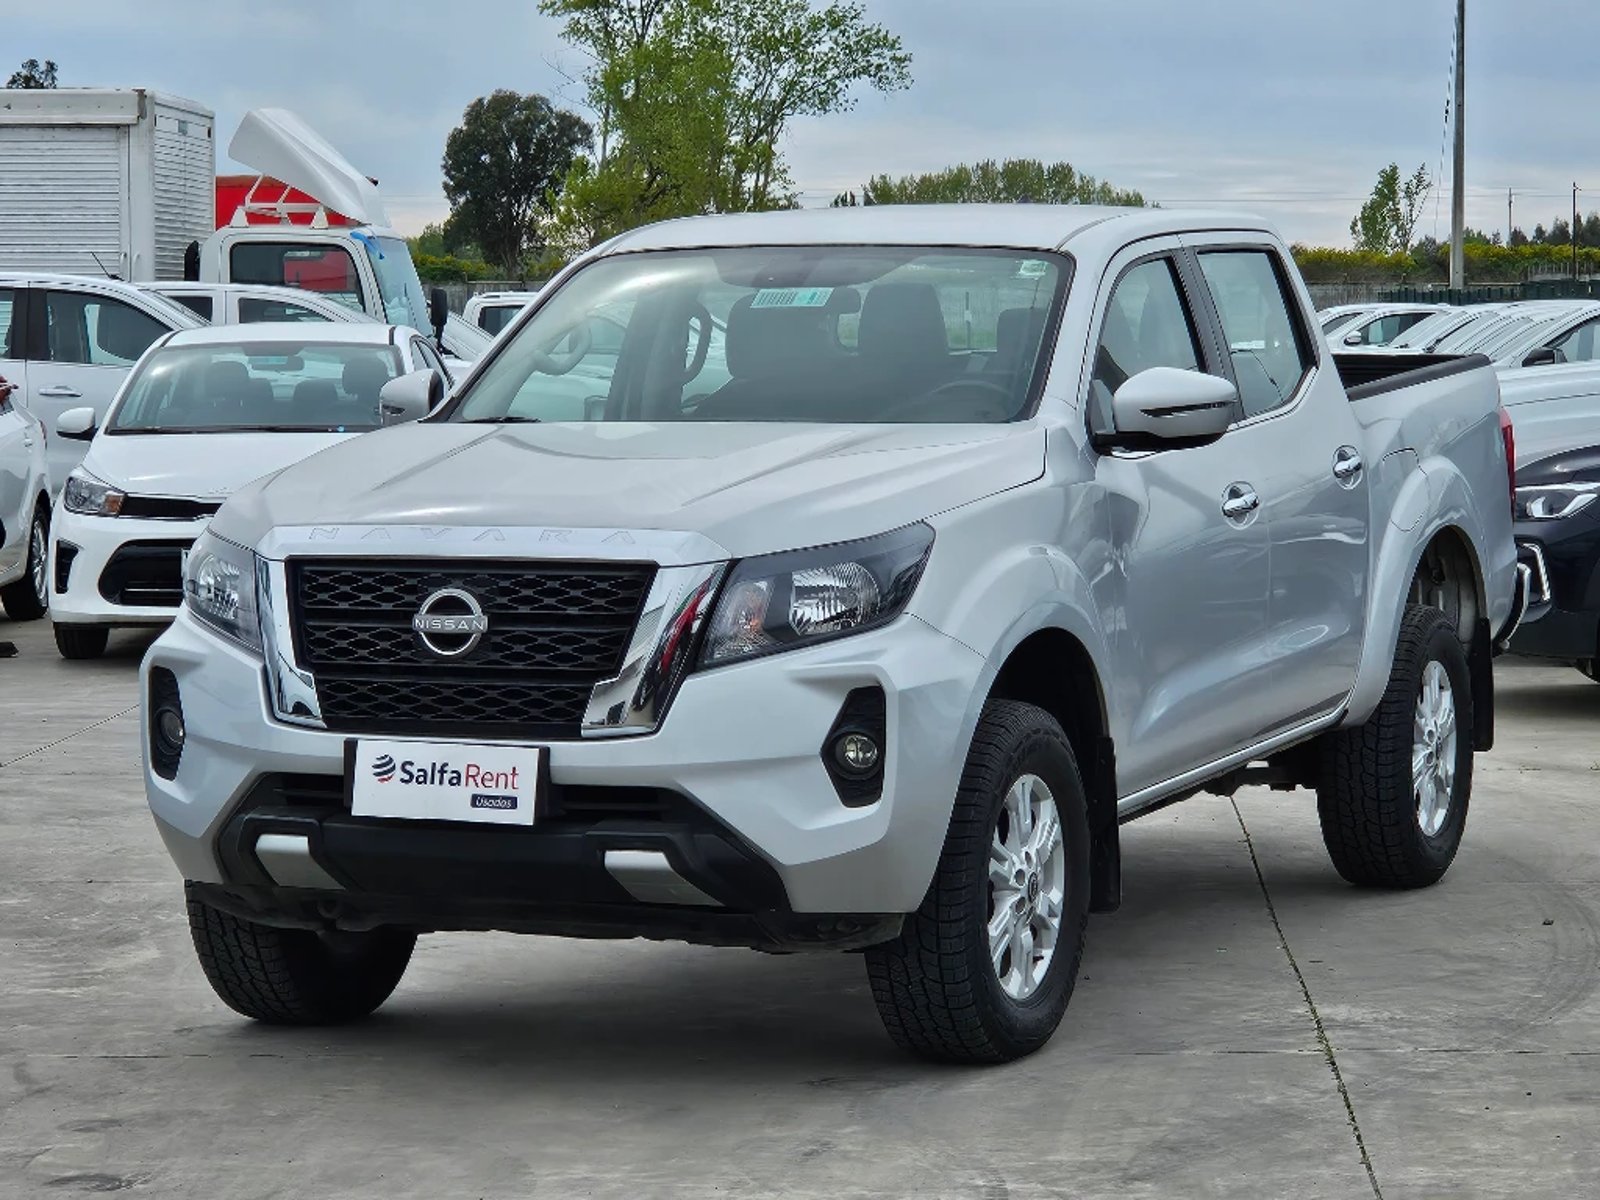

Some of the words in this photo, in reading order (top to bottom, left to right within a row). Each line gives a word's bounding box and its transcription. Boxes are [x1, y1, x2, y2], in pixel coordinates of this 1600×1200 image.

[308, 527, 636, 544] NAVARA
[415, 618, 485, 631] NISSAN
[399, 760, 520, 790] SalfaRent
[475, 796, 512, 809] Usados
